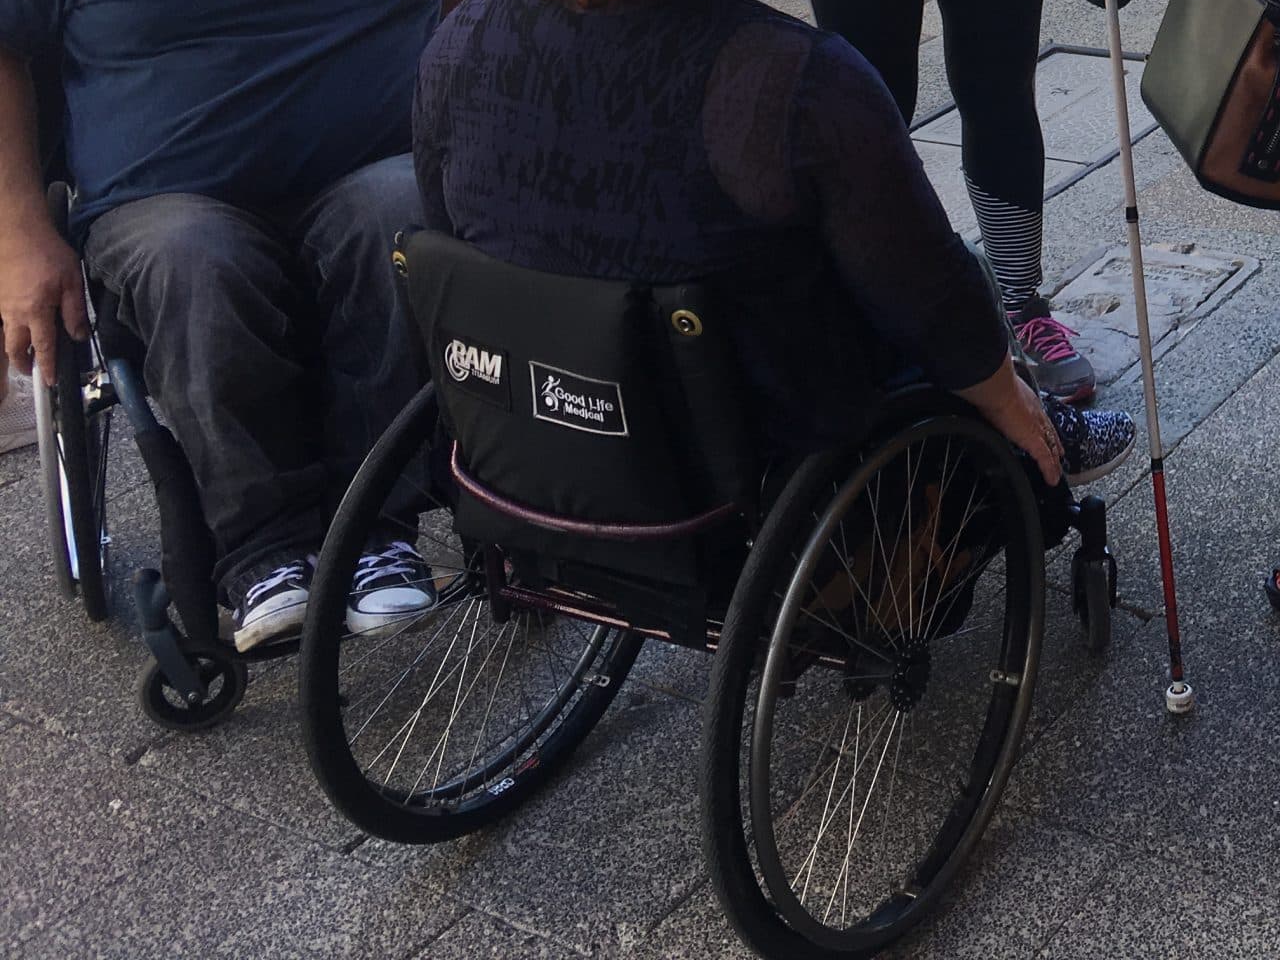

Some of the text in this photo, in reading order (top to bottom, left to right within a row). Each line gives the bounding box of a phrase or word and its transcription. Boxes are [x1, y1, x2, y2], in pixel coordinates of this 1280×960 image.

[555, 387, 614, 412] Good Life
[563, 402, 604, 423] Medical
